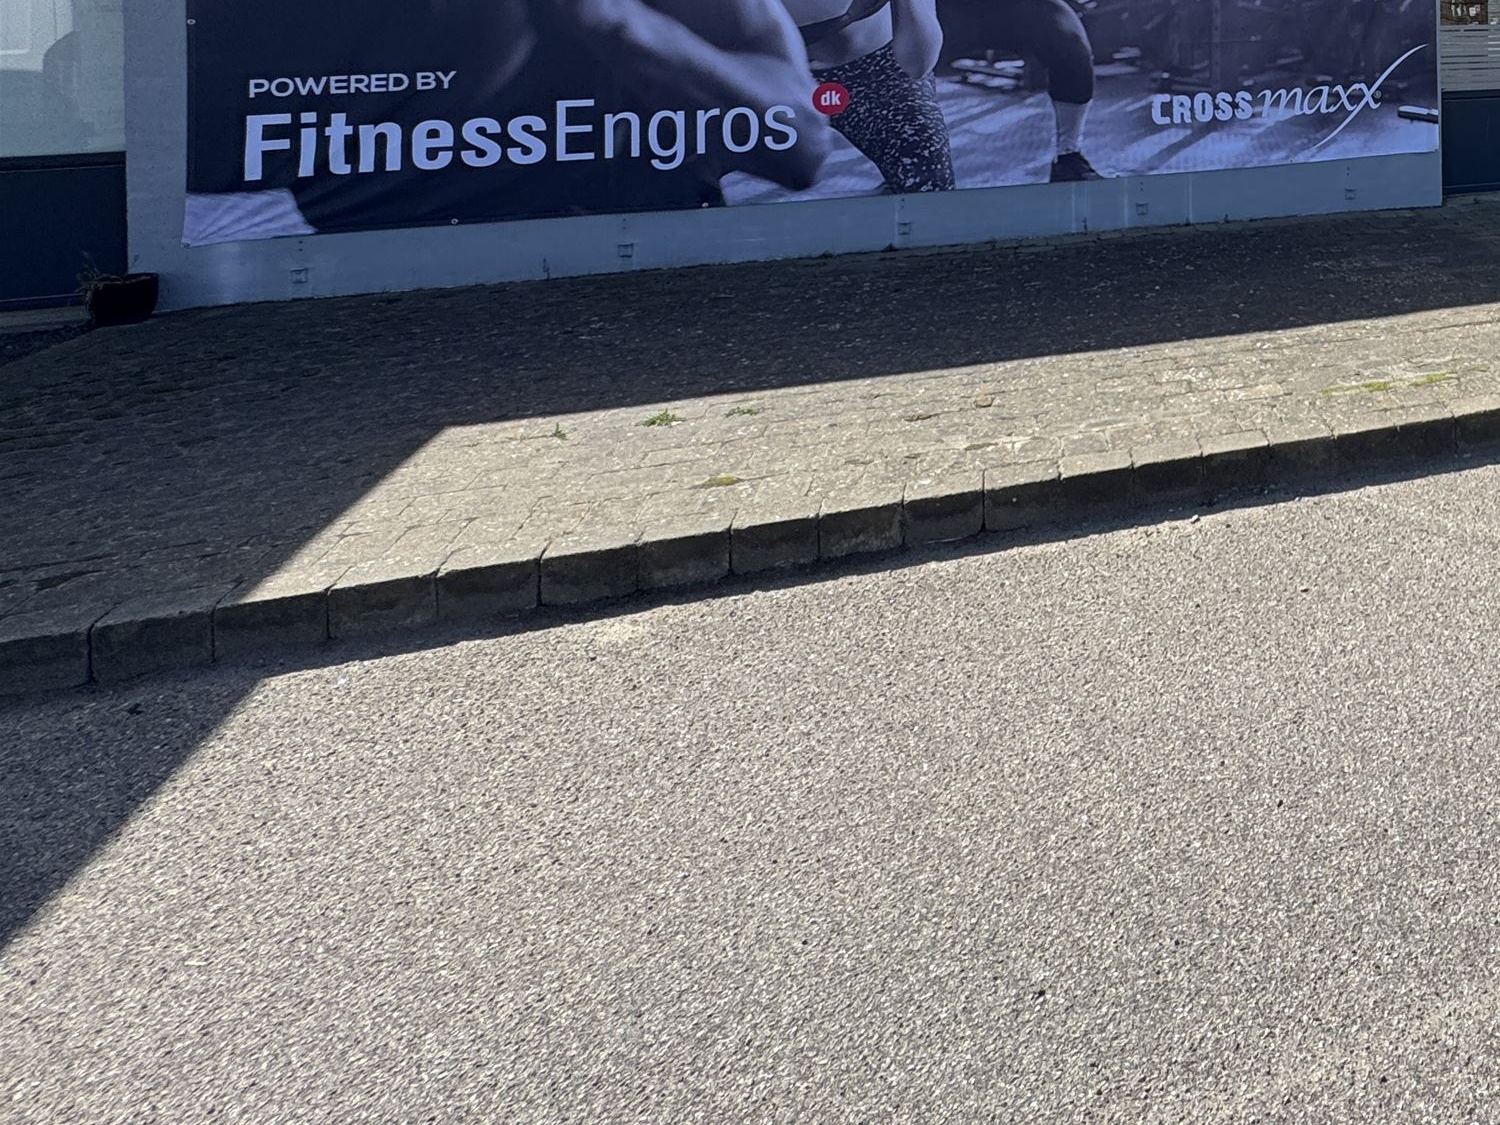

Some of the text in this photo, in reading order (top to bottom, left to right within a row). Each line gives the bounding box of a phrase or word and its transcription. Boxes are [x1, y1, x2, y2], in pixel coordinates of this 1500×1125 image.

[249, 71, 457, 98] POWERED BY
[820, 90, 842, 107] dk
